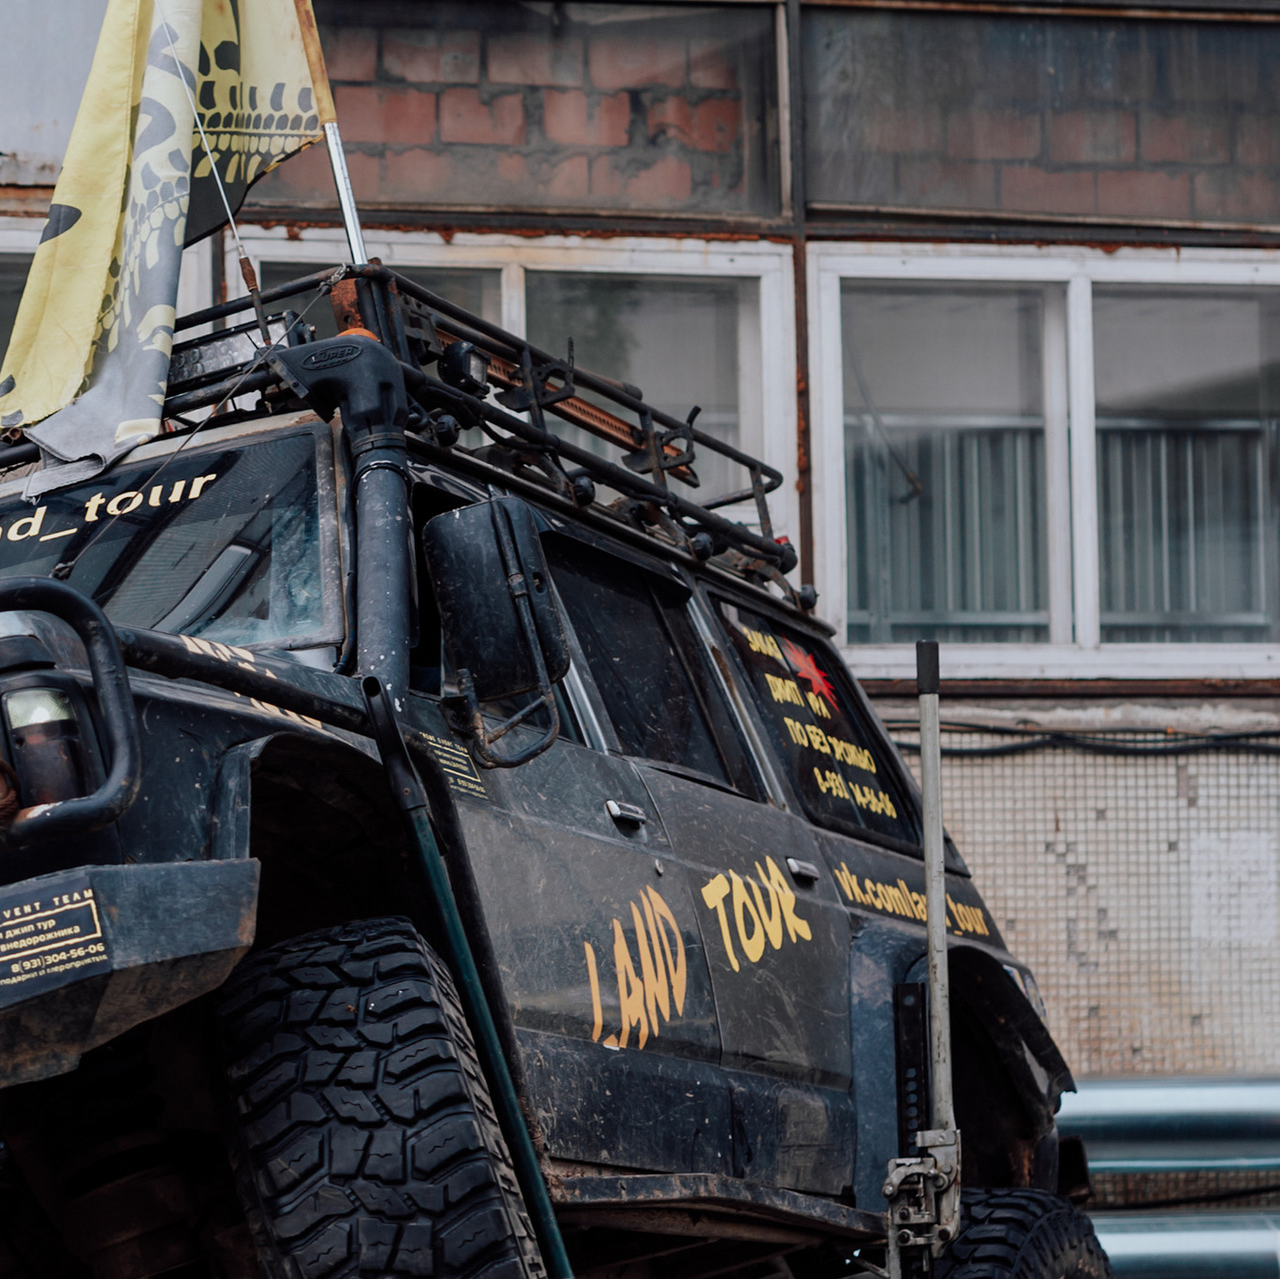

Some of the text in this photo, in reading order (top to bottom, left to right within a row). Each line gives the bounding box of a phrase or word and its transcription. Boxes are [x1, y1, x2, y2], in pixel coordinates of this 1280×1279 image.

[764, 672, 806, 708] ДЖИП
[783, 716, 809, 748] ПО
[52, 888, 94, 907] TEAM
[0, 924, 82, 952] внедорожника
[5, 923, 36, 940] джип
[36, 918, 57, 935] тур
[10, 942, 106, 974] 8(931)304-56-06
[584, 855, 813, 1050] LAND TOUR
